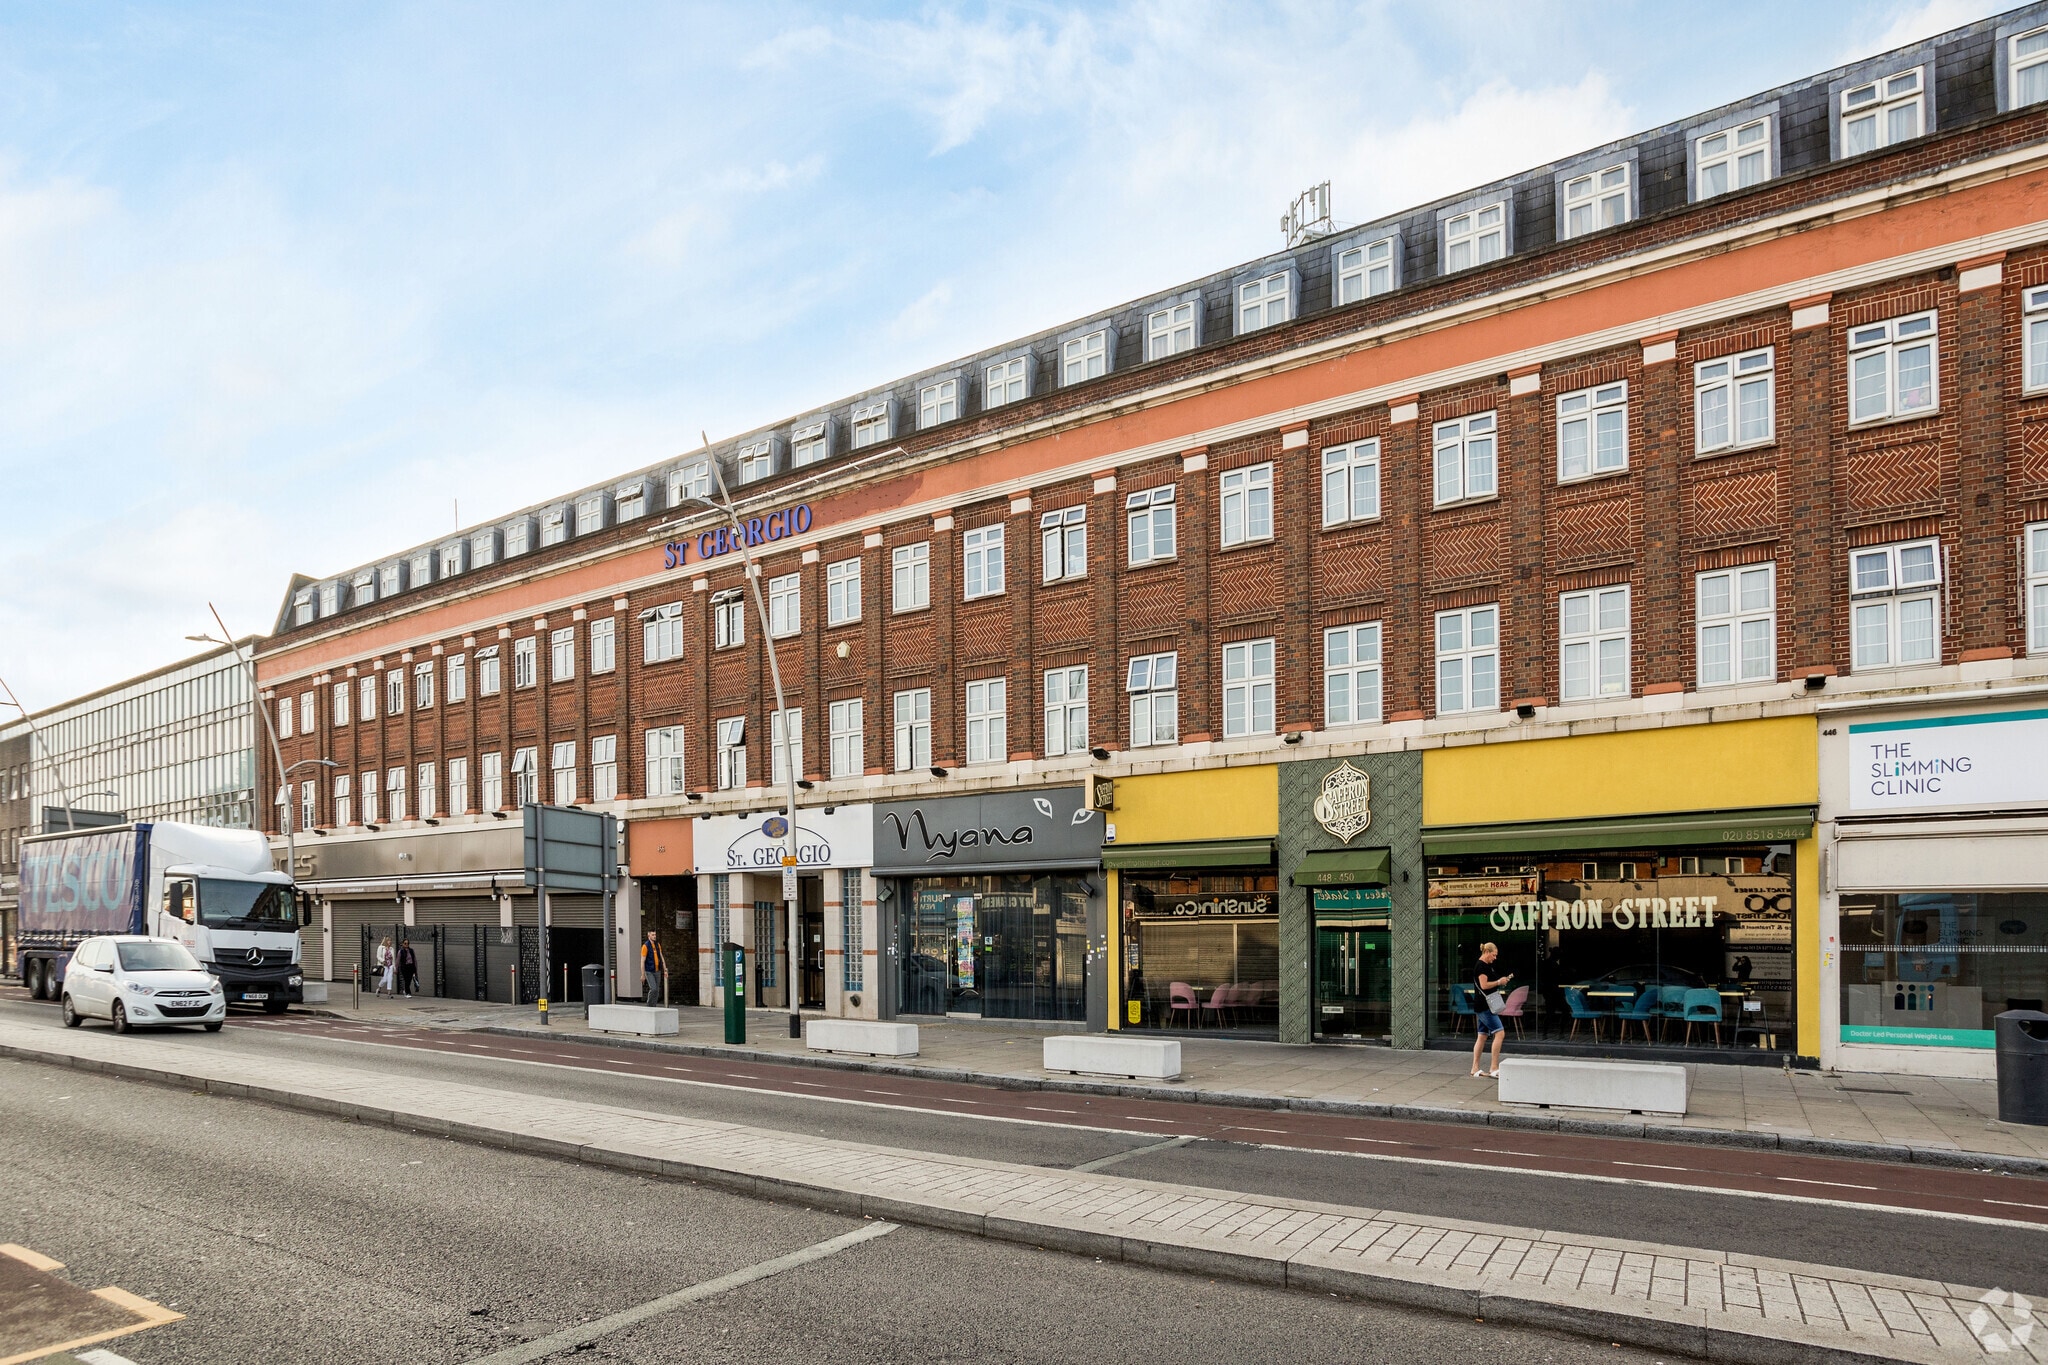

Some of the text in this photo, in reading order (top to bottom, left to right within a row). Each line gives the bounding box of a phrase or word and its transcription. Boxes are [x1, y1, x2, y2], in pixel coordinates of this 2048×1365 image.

[697, 504, 813, 559] GEORGIO
[1822, 728, 1837, 737] 446
[1871, 742, 1911, 760] THE
[1871, 777, 1941, 796] CLINIC
[1316, 781, 1368, 819] SAFFRON
[1333, 795, 1368, 821] STREET
[882, 808, 1034, 862] Nyana
[1722, 828, 1806, 841] 020 8518 5444
[753, 844, 831, 866] GEOGIO
[25, 849, 126, 913] TESCO
[1317, 873, 1332, 882] 448
[1339, 872, 1355, 882] 450
[1489, 895, 1718, 932] SAFFRON STREET
[1850, 1030, 1872, 1038] Doctor
[1886, 1031, 1914, 1039] Personal
[1914, 1032, 1938, 1041] Weight
[1938, 1033, 1954, 1041] Loss
